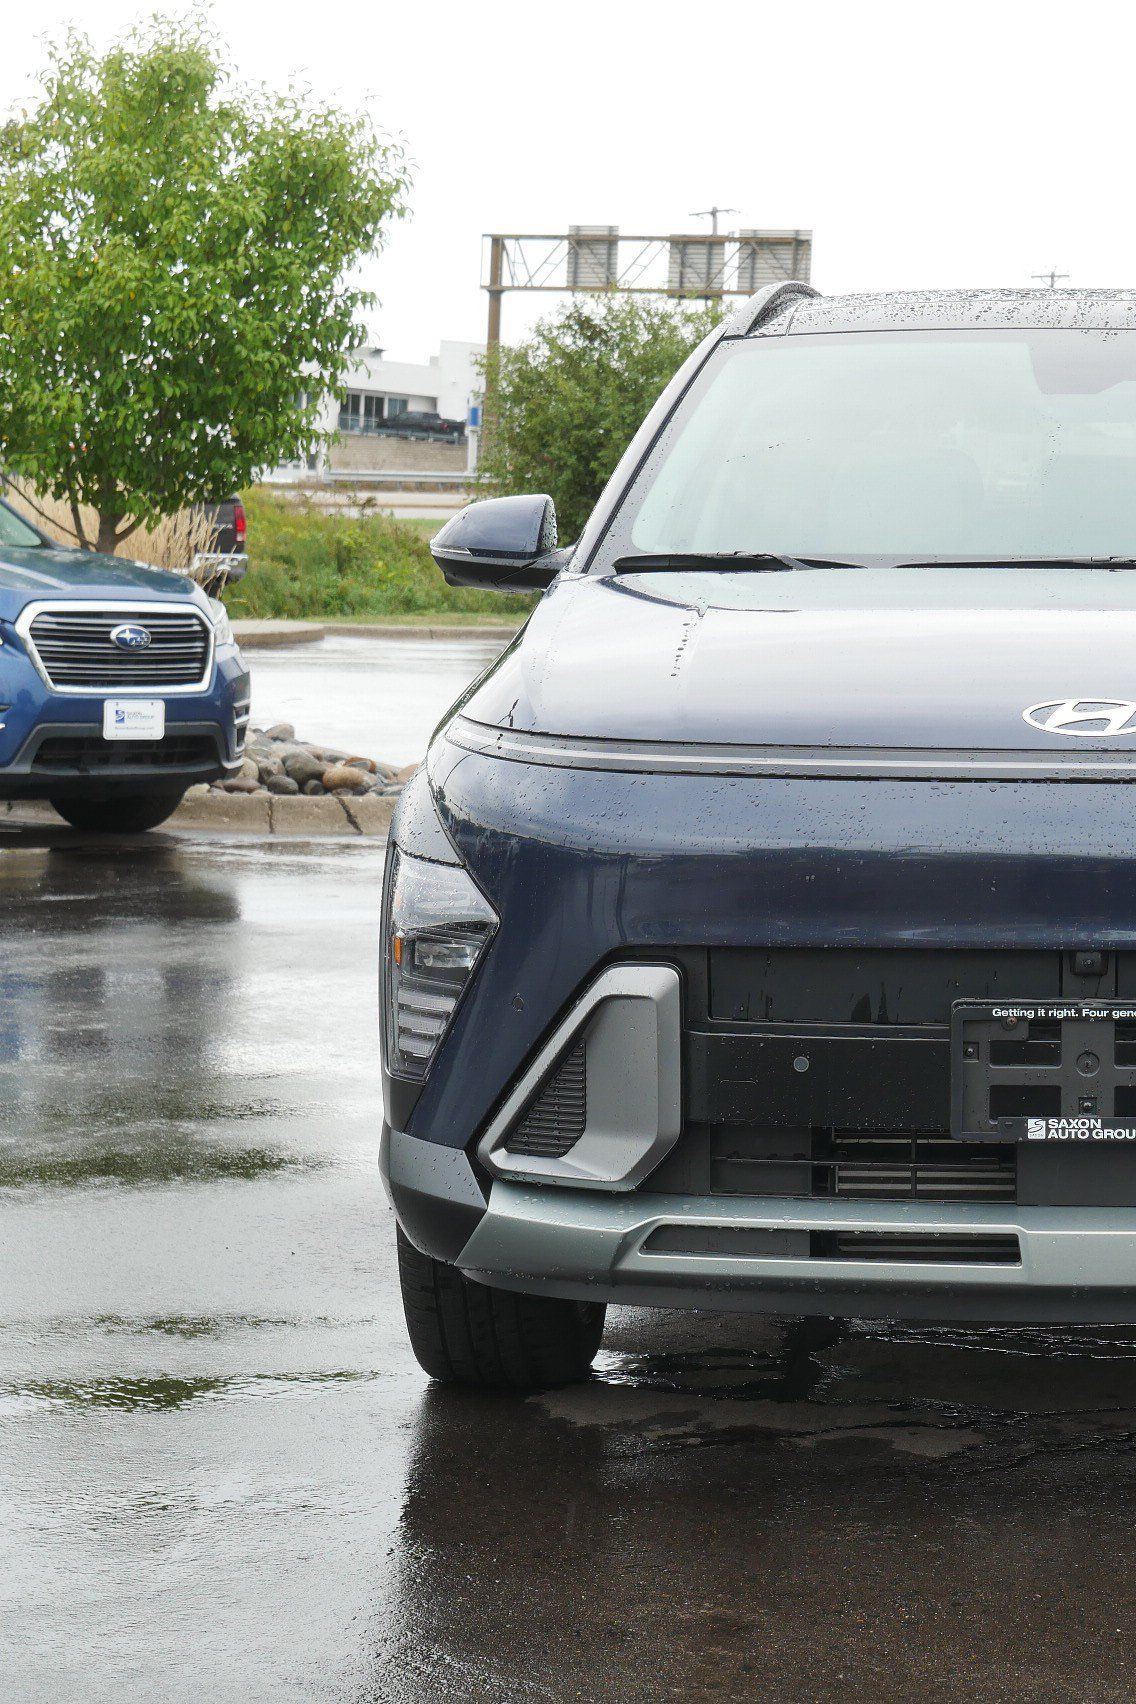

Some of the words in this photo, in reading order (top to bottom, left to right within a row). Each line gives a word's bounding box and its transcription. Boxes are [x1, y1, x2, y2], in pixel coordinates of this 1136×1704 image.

[992, 1008, 1035, 1019] Getting
[1037, 1008, 1046, 1017] it
[1048, 1008, 1079, 1019] right.
[1082, 1008, 1109, 1018] Four
[1047, 1118, 1102, 1129] SAXON
[1047, 1129, 1089, 1140] AUTO
